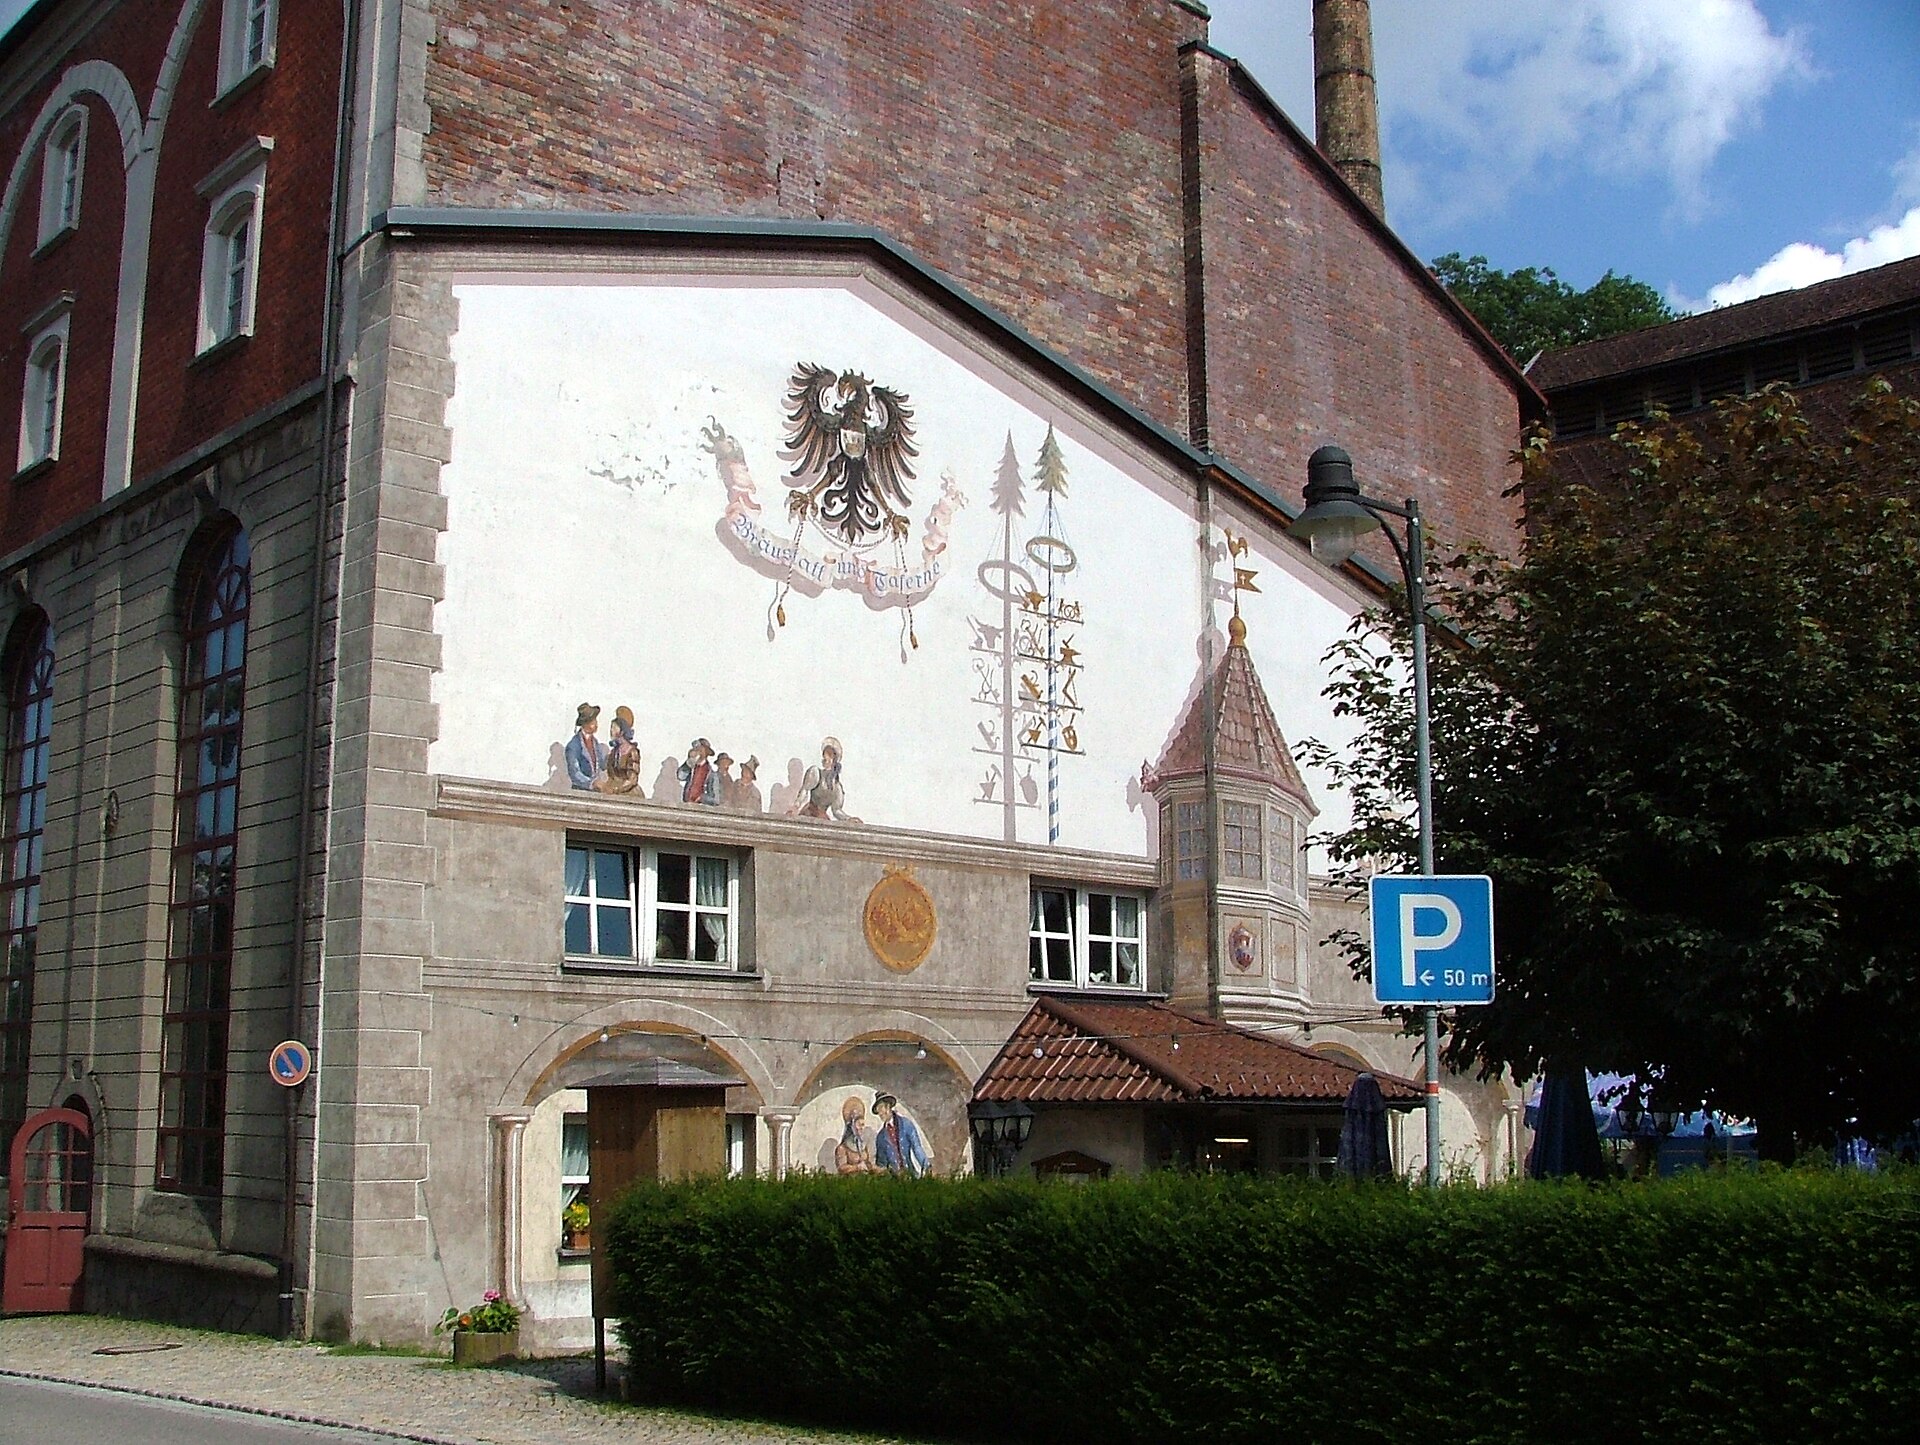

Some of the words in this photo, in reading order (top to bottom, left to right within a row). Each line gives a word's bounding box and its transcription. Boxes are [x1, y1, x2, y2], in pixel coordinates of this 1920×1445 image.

[873, 561, 940, 594] Taferne
[1399, 893, 1462, 987] P
[1444, 969, 1465, 987] 50
[1471, 974, 1488, 986] m
